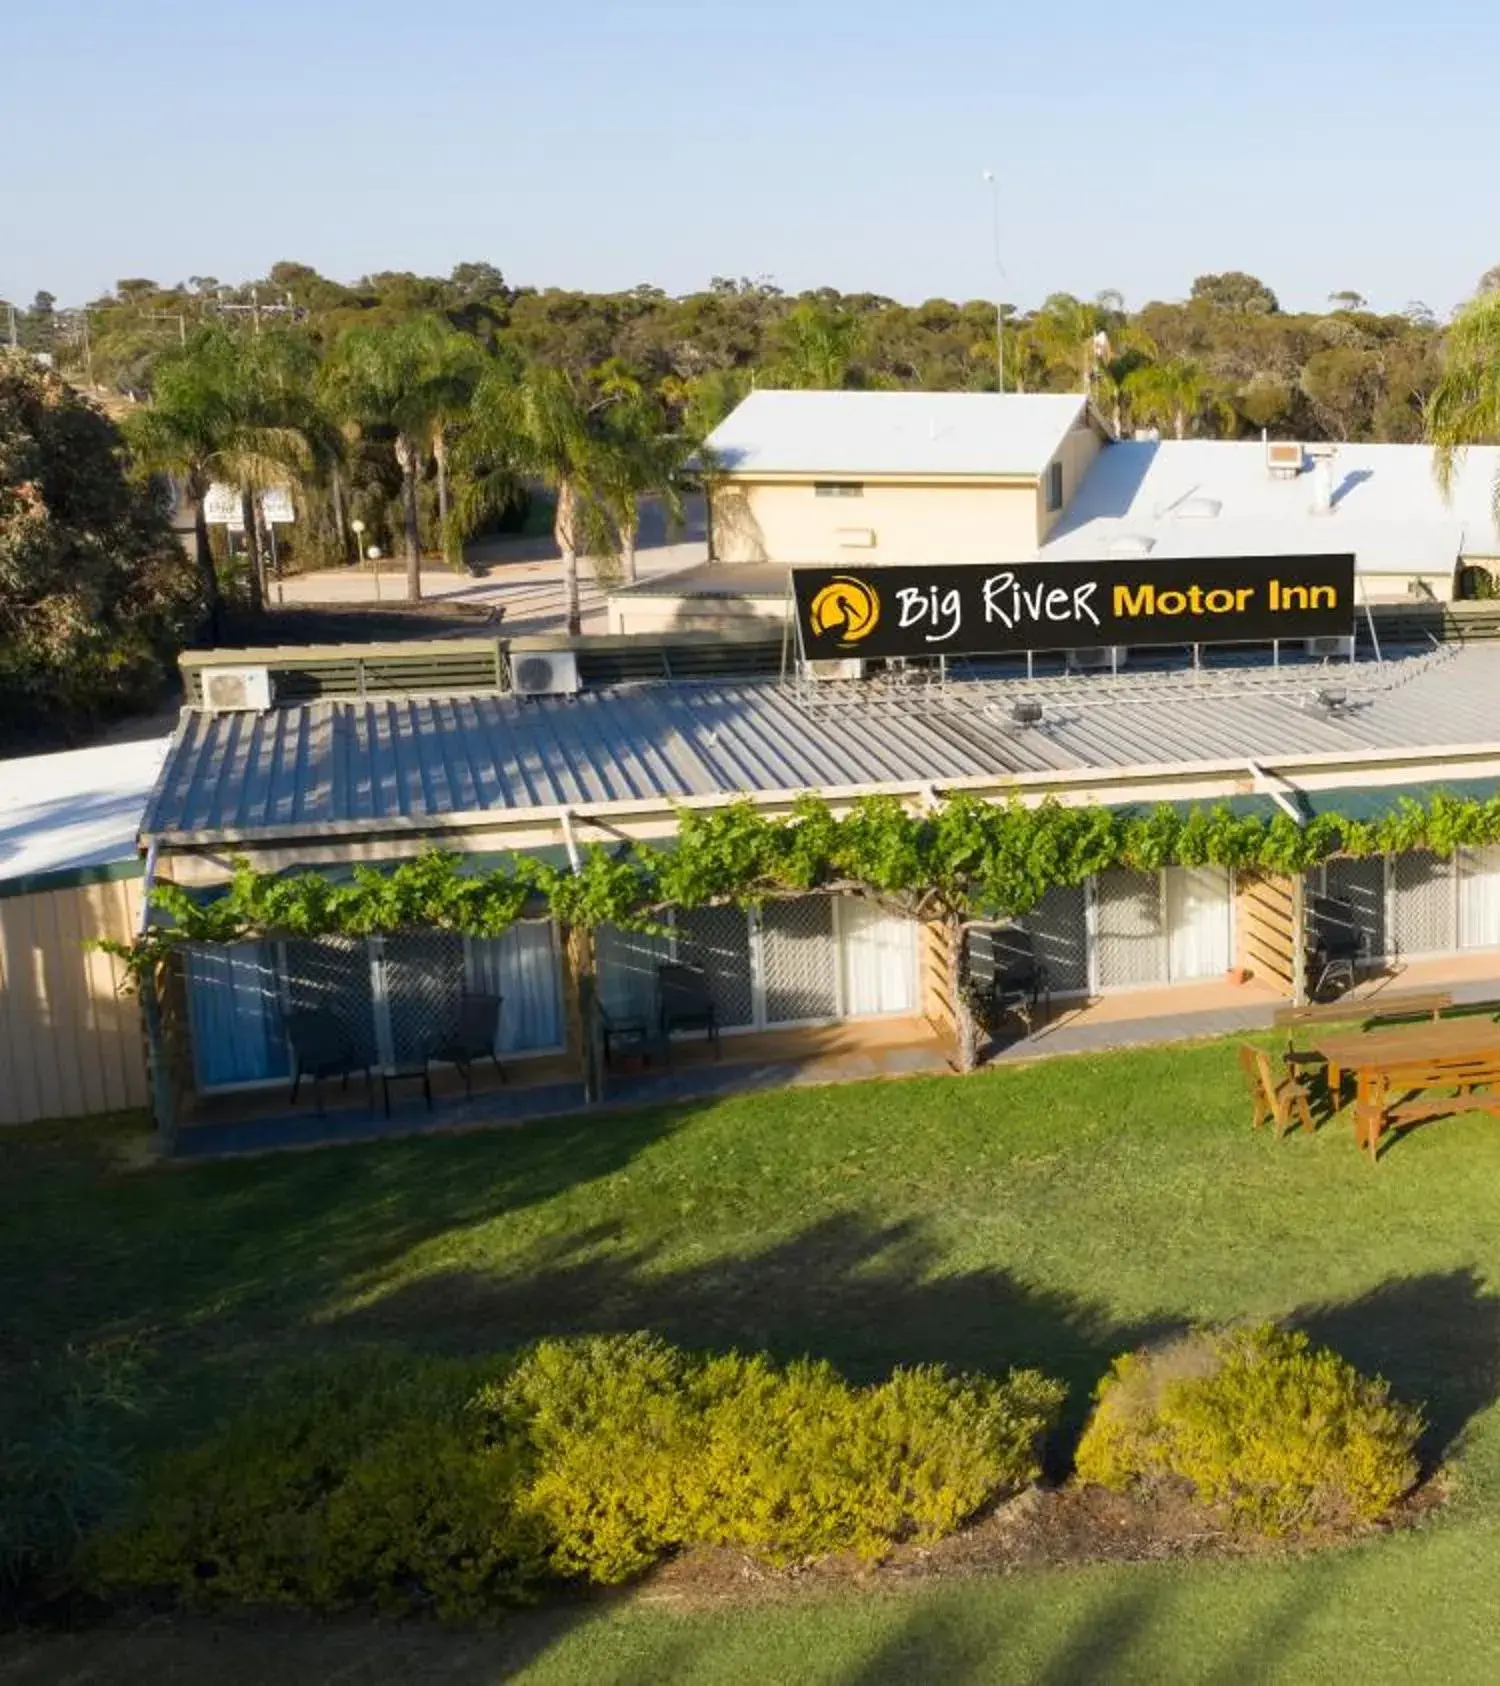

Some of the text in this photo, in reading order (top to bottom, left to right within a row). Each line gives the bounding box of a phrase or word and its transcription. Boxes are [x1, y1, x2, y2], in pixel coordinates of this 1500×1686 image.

[896, 586, 960, 641] Big
[1114, 585, 1254, 616] Motor
[1270, 580, 1336, 610] Inn
